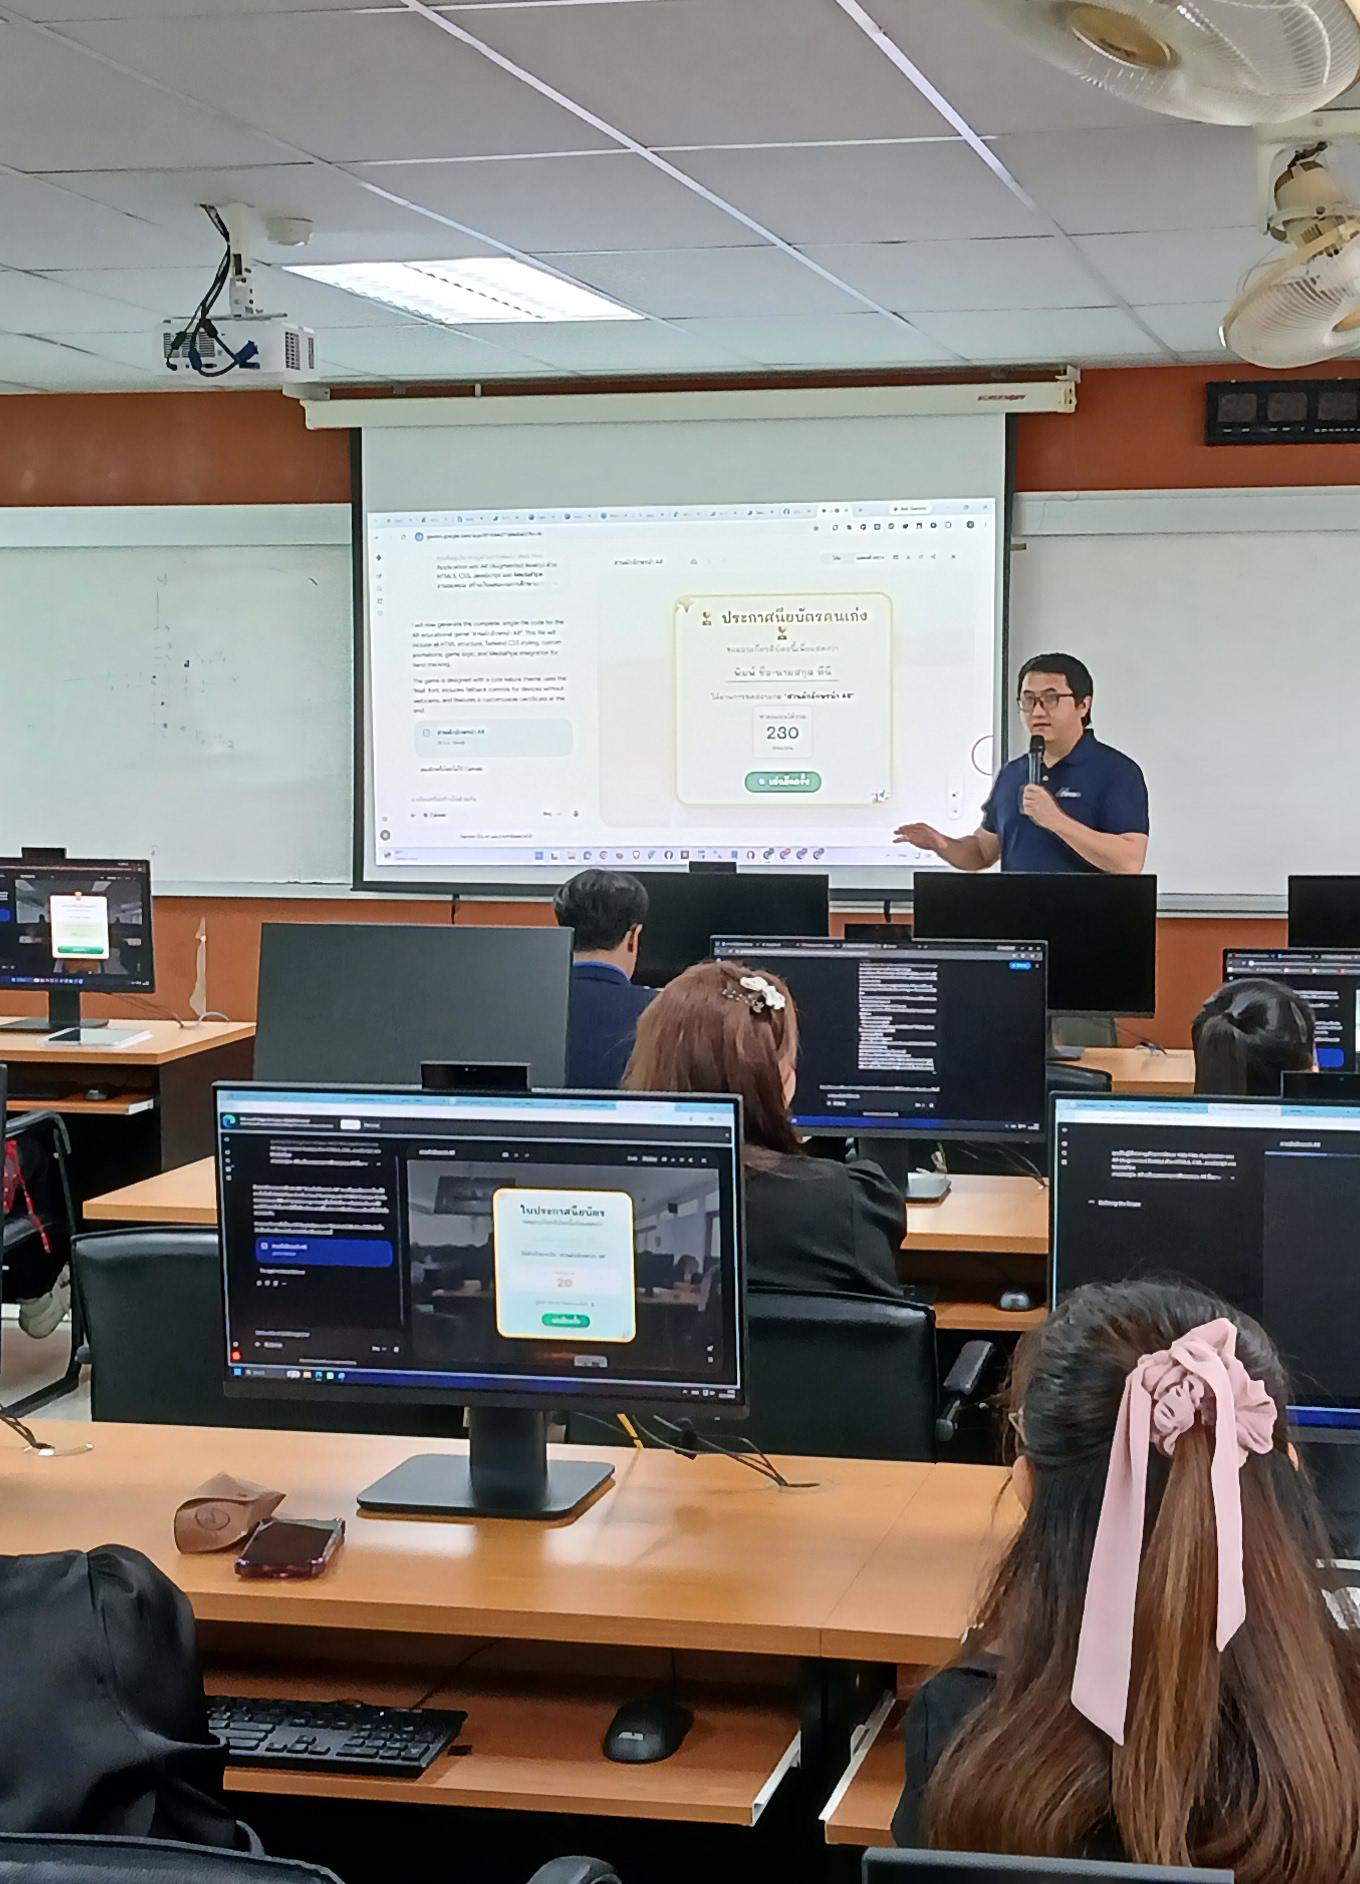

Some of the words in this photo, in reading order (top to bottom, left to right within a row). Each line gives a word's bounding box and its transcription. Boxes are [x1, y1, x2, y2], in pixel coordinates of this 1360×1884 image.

[722, 607, 868, 624] ประกาศนียบัตรคนเก่ง
[766, 726, 799, 740] 230
[520, 1204, 605, 1216] ใบประกาศนียบัตร
